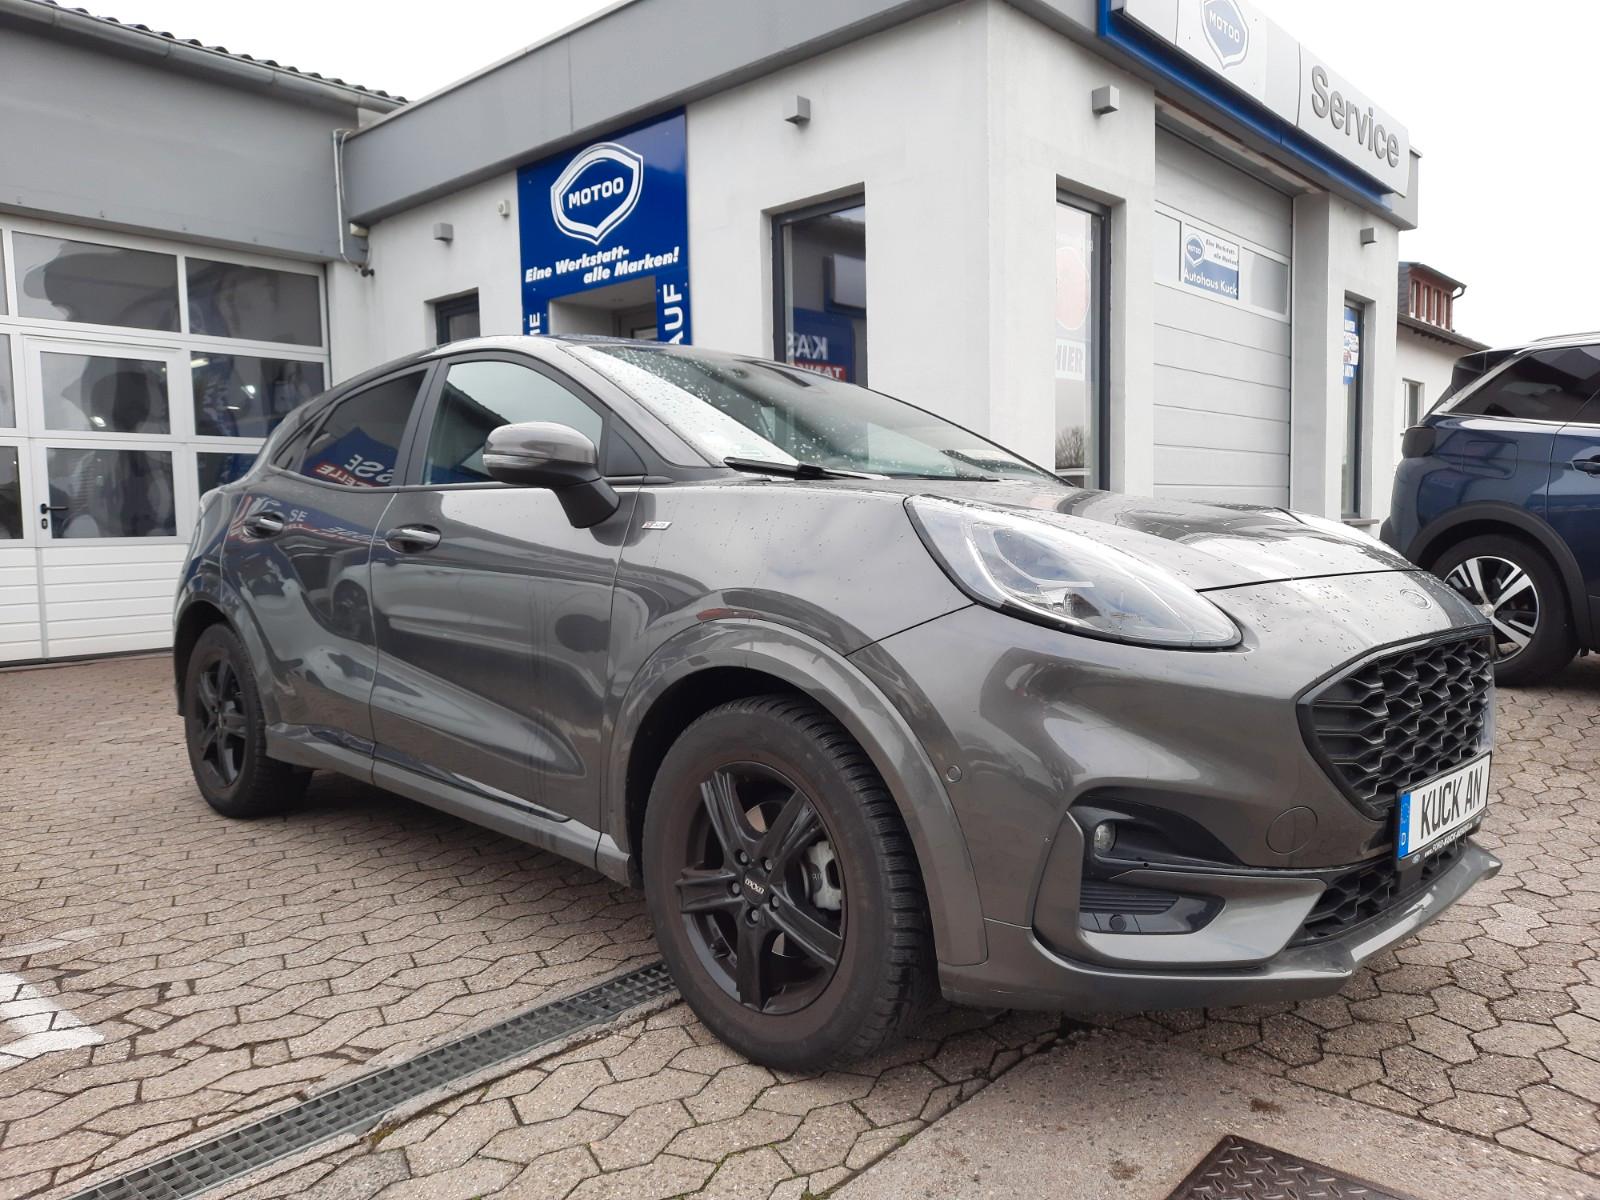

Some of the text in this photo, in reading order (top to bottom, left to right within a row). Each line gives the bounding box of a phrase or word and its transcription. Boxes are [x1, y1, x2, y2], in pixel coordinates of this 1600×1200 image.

[1209, 9, 1240, 43] MOTOO
[1311, 65, 1399, 168] Service
[568, 177, 624, 209] MOTOO
[525, 245, 629, 283] Eine Werkstatt-
[583, 246, 680, 284] alle Marken!
[1184, 267, 1237, 296] Autohaus Kuck
[1420, 765, 1483, 840] KUCK AN
[1401, 832, 1407, 846] D
